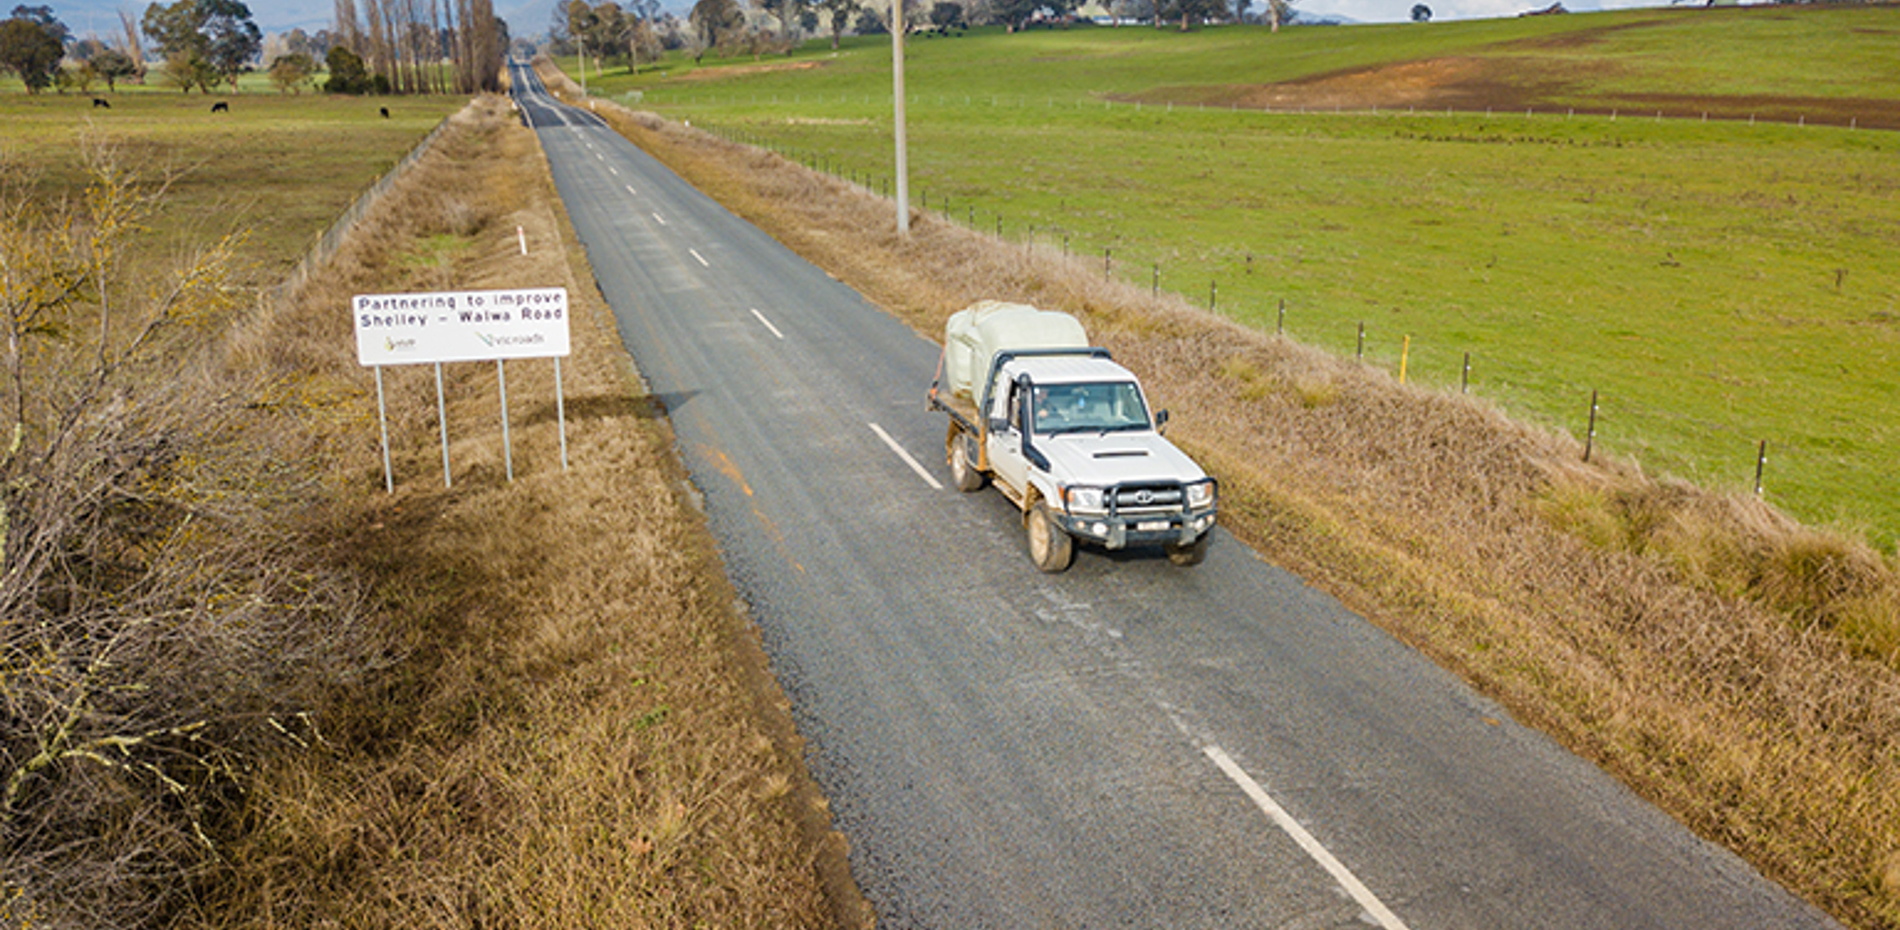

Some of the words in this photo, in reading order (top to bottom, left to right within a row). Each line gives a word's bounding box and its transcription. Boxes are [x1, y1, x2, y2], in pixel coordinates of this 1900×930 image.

[358, 297, 456, 310] Partnering
[467, 295, 485, 306] to
[493, 292, 562, 306] improve
[360, 314, 428, 328] Shelley
[459, 310, 511, 322] Walwa
[521, 307, 562, 320] Road
